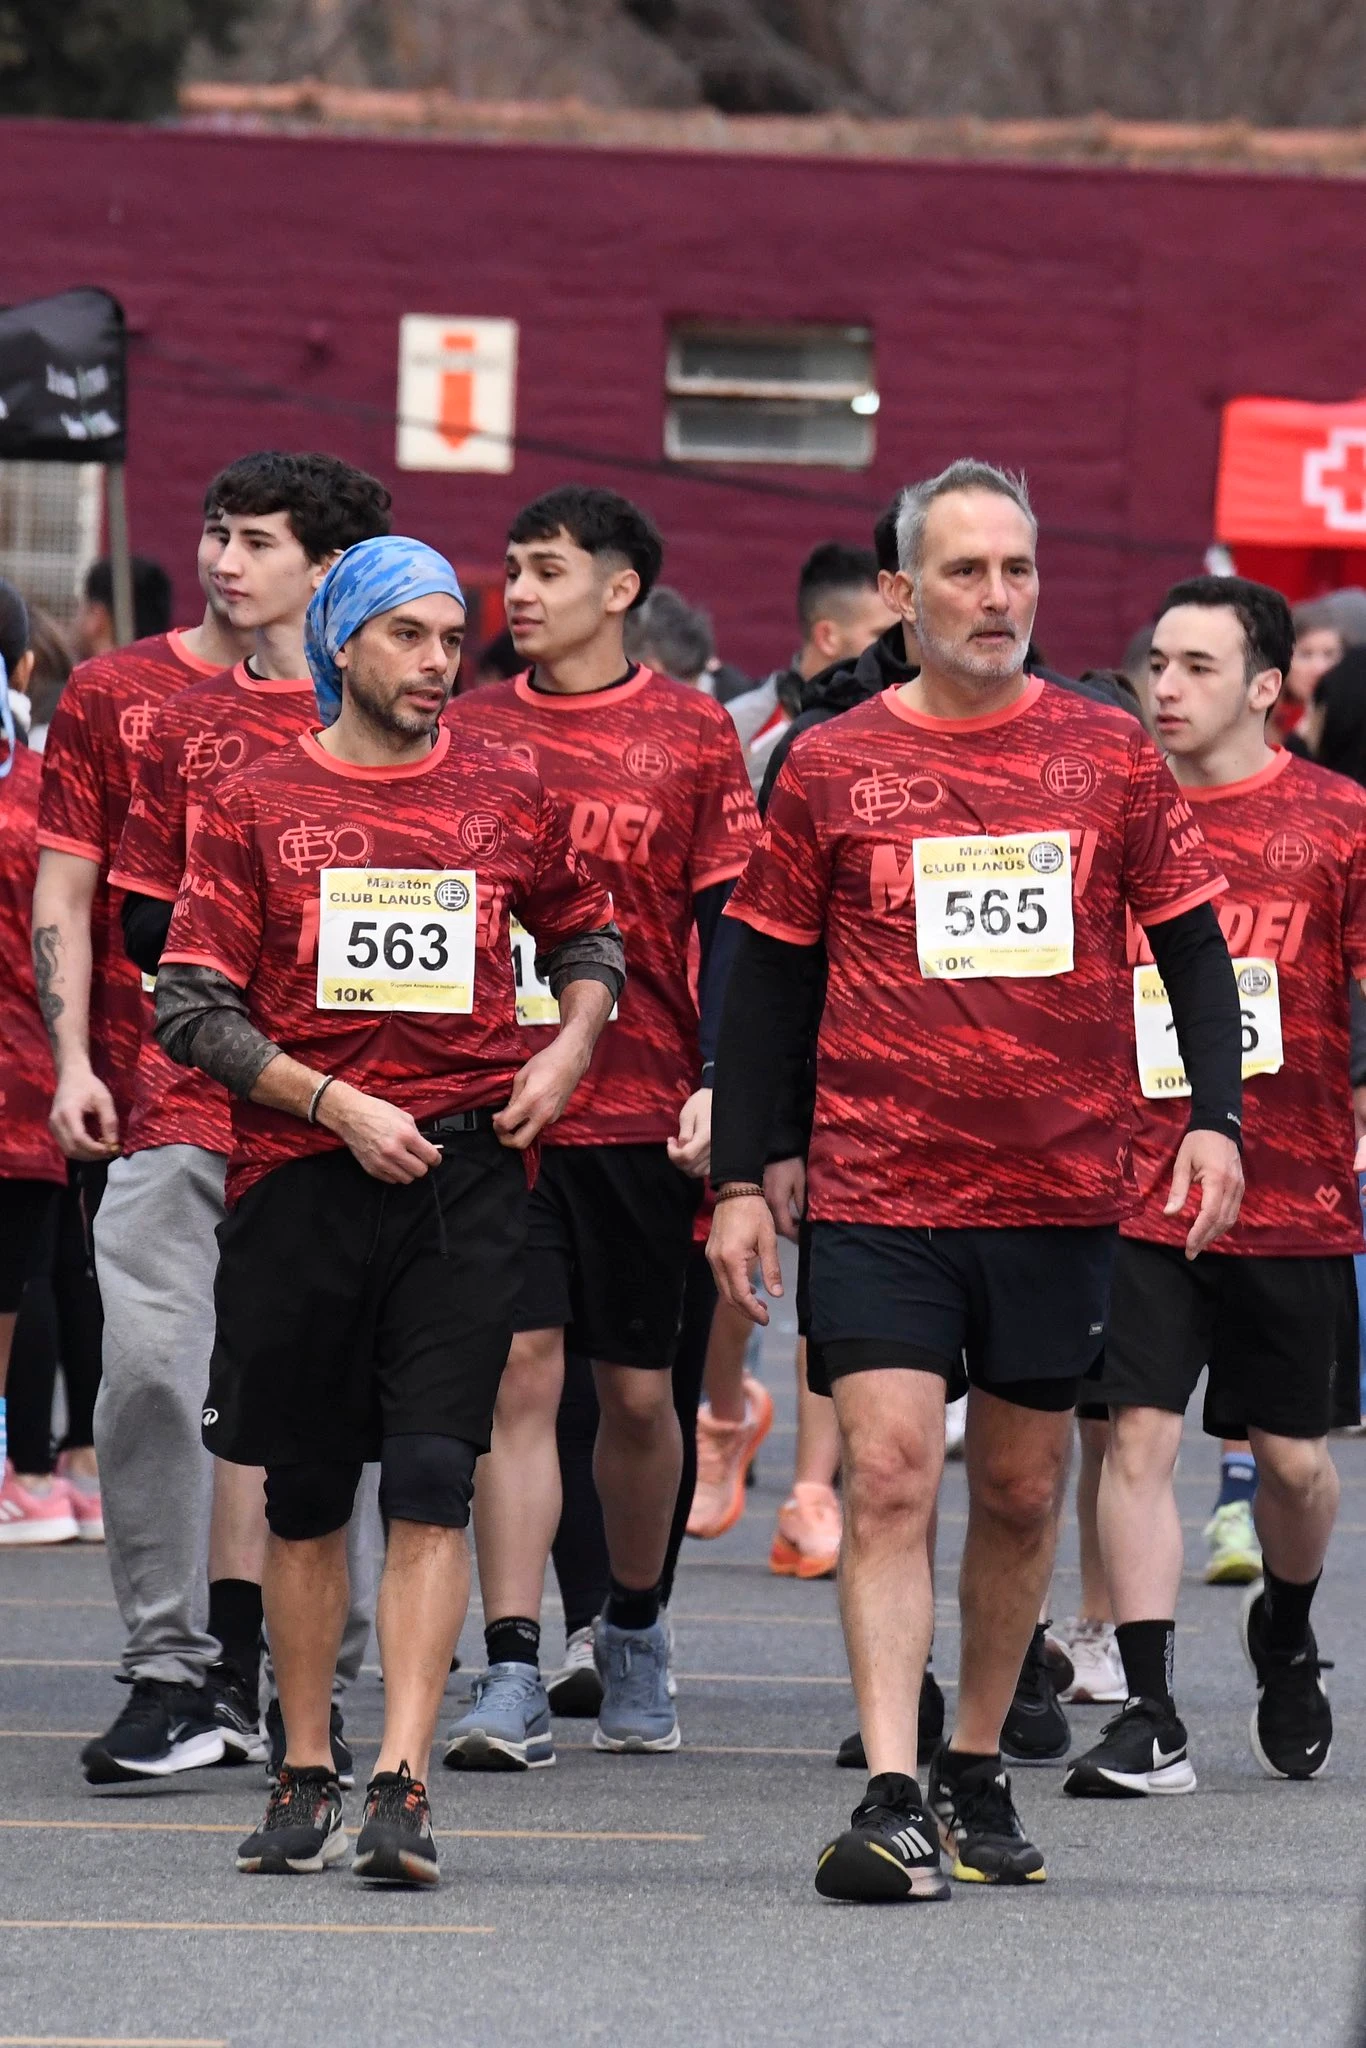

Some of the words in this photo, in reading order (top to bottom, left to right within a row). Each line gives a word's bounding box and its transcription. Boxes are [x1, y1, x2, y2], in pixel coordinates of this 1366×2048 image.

[923, 863, 966, 875] CLUB
[972, 858, 1026, 872] LANÚS
[367, 877, 432, 890] Maratón
[330, 892, 373, 904] CLUB
[379, 892, 432, 906] LANÚS
[945, 887, 1048, 937] 565
[346, 921, 449, 972] 563
[936, 956, 976, 971] 10K
[334, 987, 375, 1002] 10K
